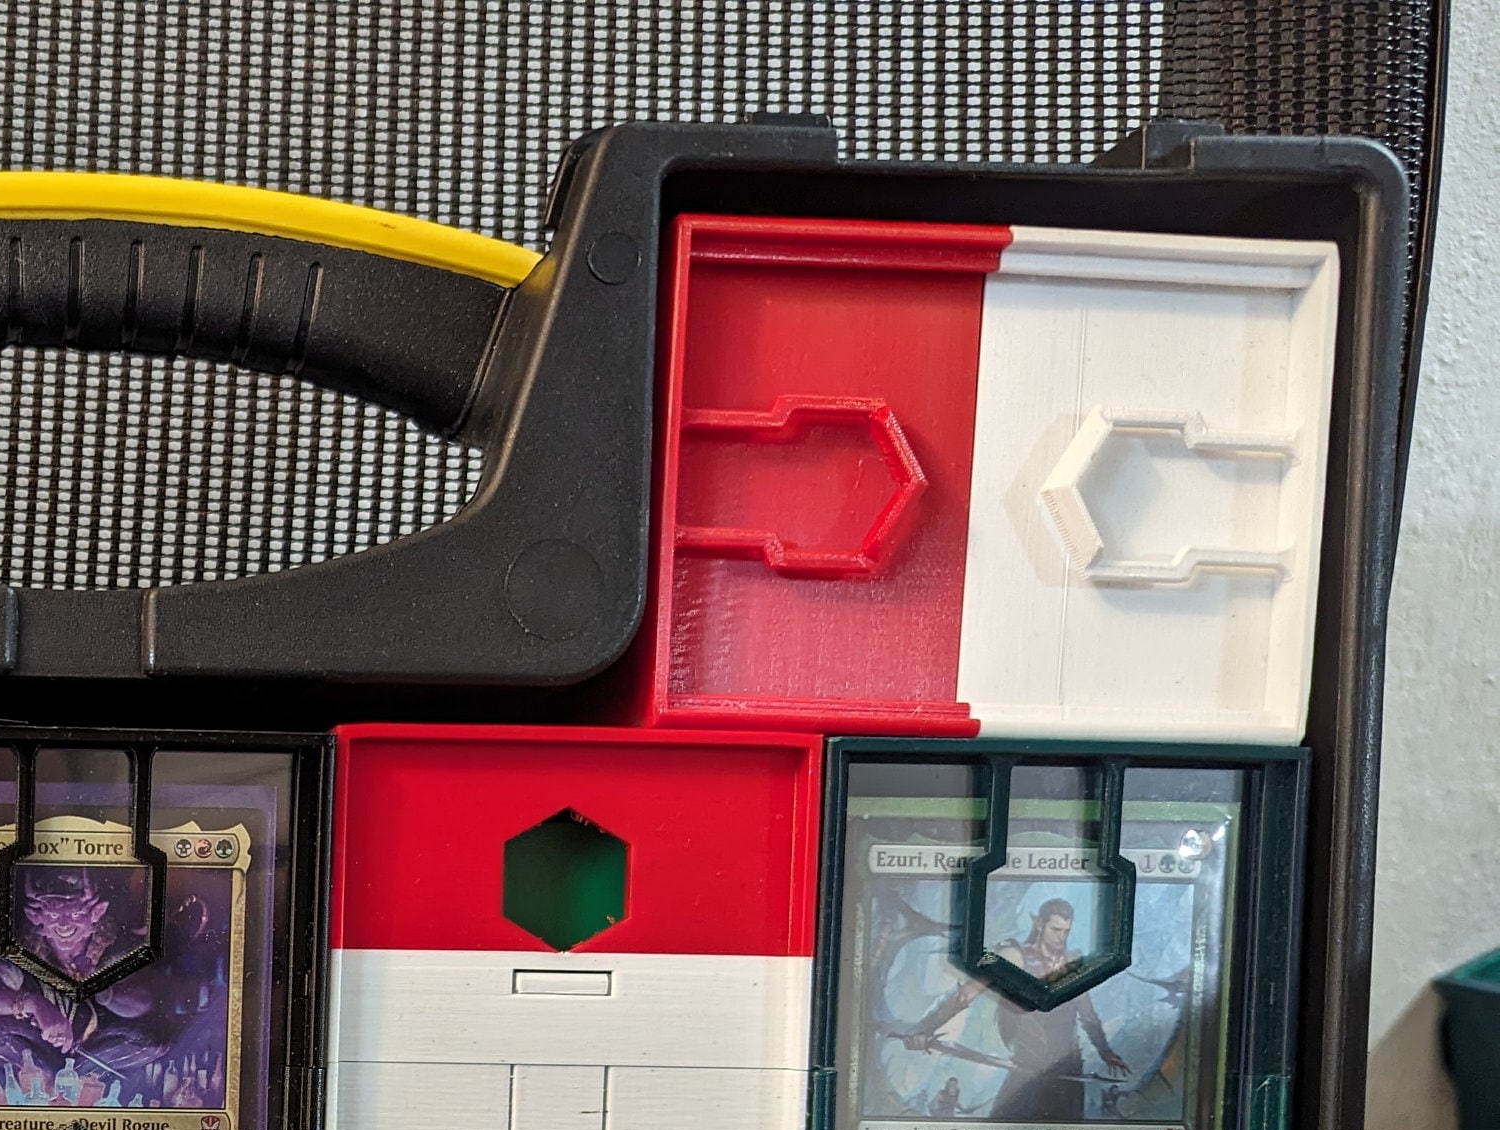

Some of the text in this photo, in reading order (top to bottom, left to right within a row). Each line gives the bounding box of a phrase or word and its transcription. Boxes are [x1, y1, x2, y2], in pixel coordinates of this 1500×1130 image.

[74, 838, 124, 856] Torre
[876, 851, 929, 870] Ezuri,
[1027, 852, 1090, 870] Leader
